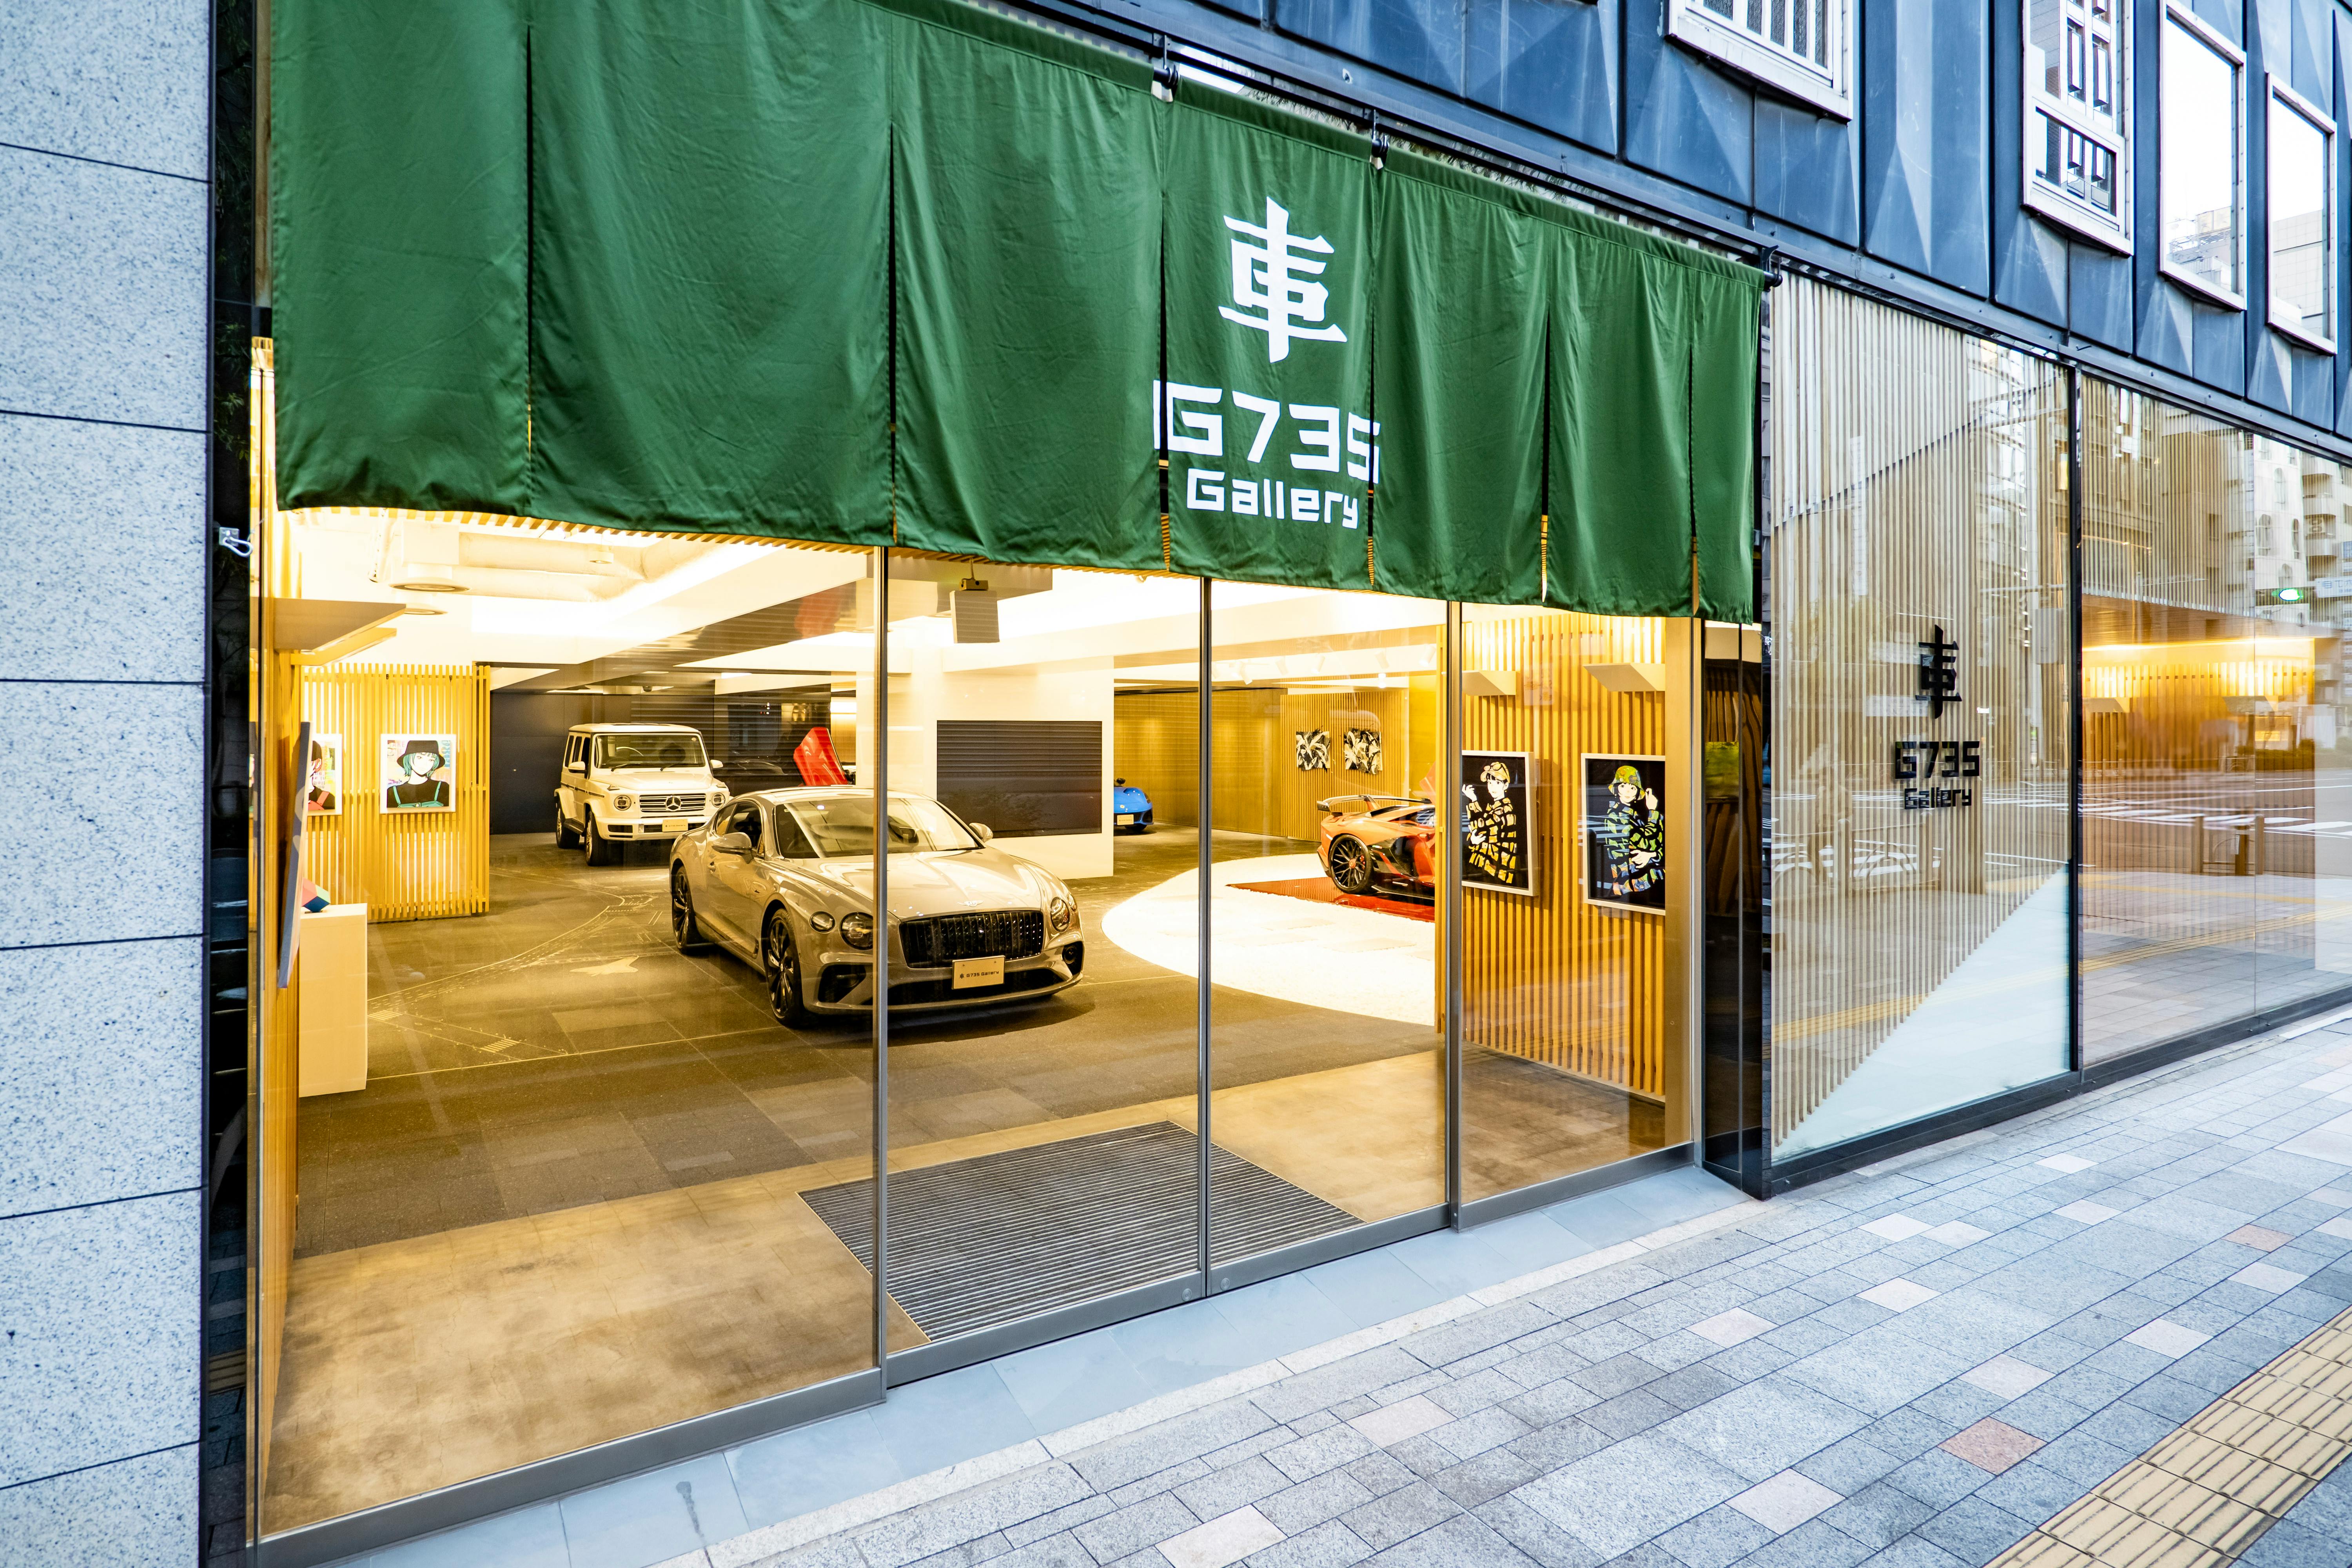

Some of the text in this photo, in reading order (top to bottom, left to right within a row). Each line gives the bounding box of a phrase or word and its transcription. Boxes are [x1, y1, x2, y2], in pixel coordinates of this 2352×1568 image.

[1218, 196, 1347, 363] 車
[1153, 379, 1380, 484] G735
[1187, 468, 1359, 529] Gallery
[1915, 624, 1962, 719] 車
[1895, 741, 1980, 779] G735
[1904, 787, 1972, 809] Gallery
